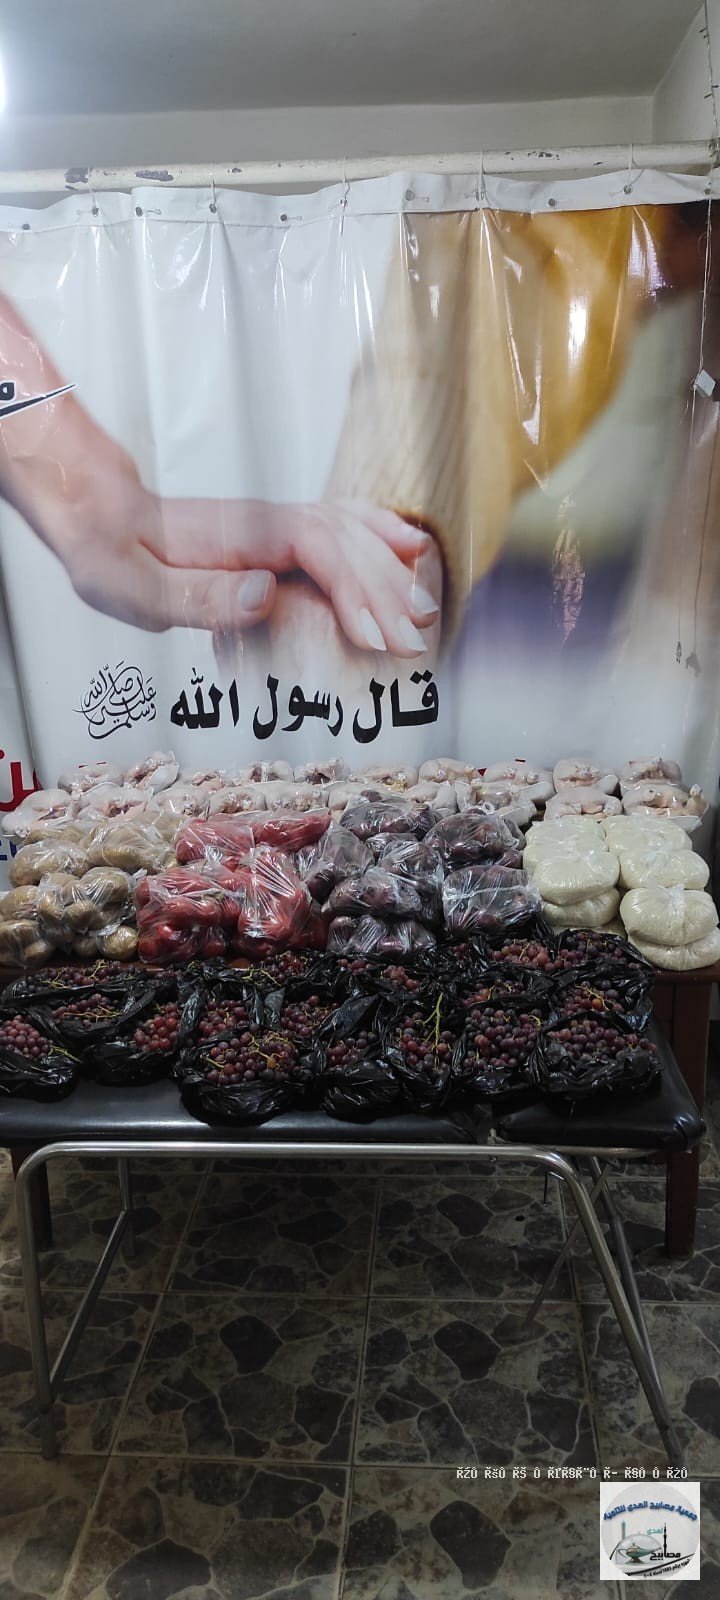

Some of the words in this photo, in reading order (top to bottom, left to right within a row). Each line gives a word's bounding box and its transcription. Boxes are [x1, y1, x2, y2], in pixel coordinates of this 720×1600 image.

[170, 666, 240, 730] الله
[252, 673, 345, 740] رسول
[352, 669, 440, 744] قال
